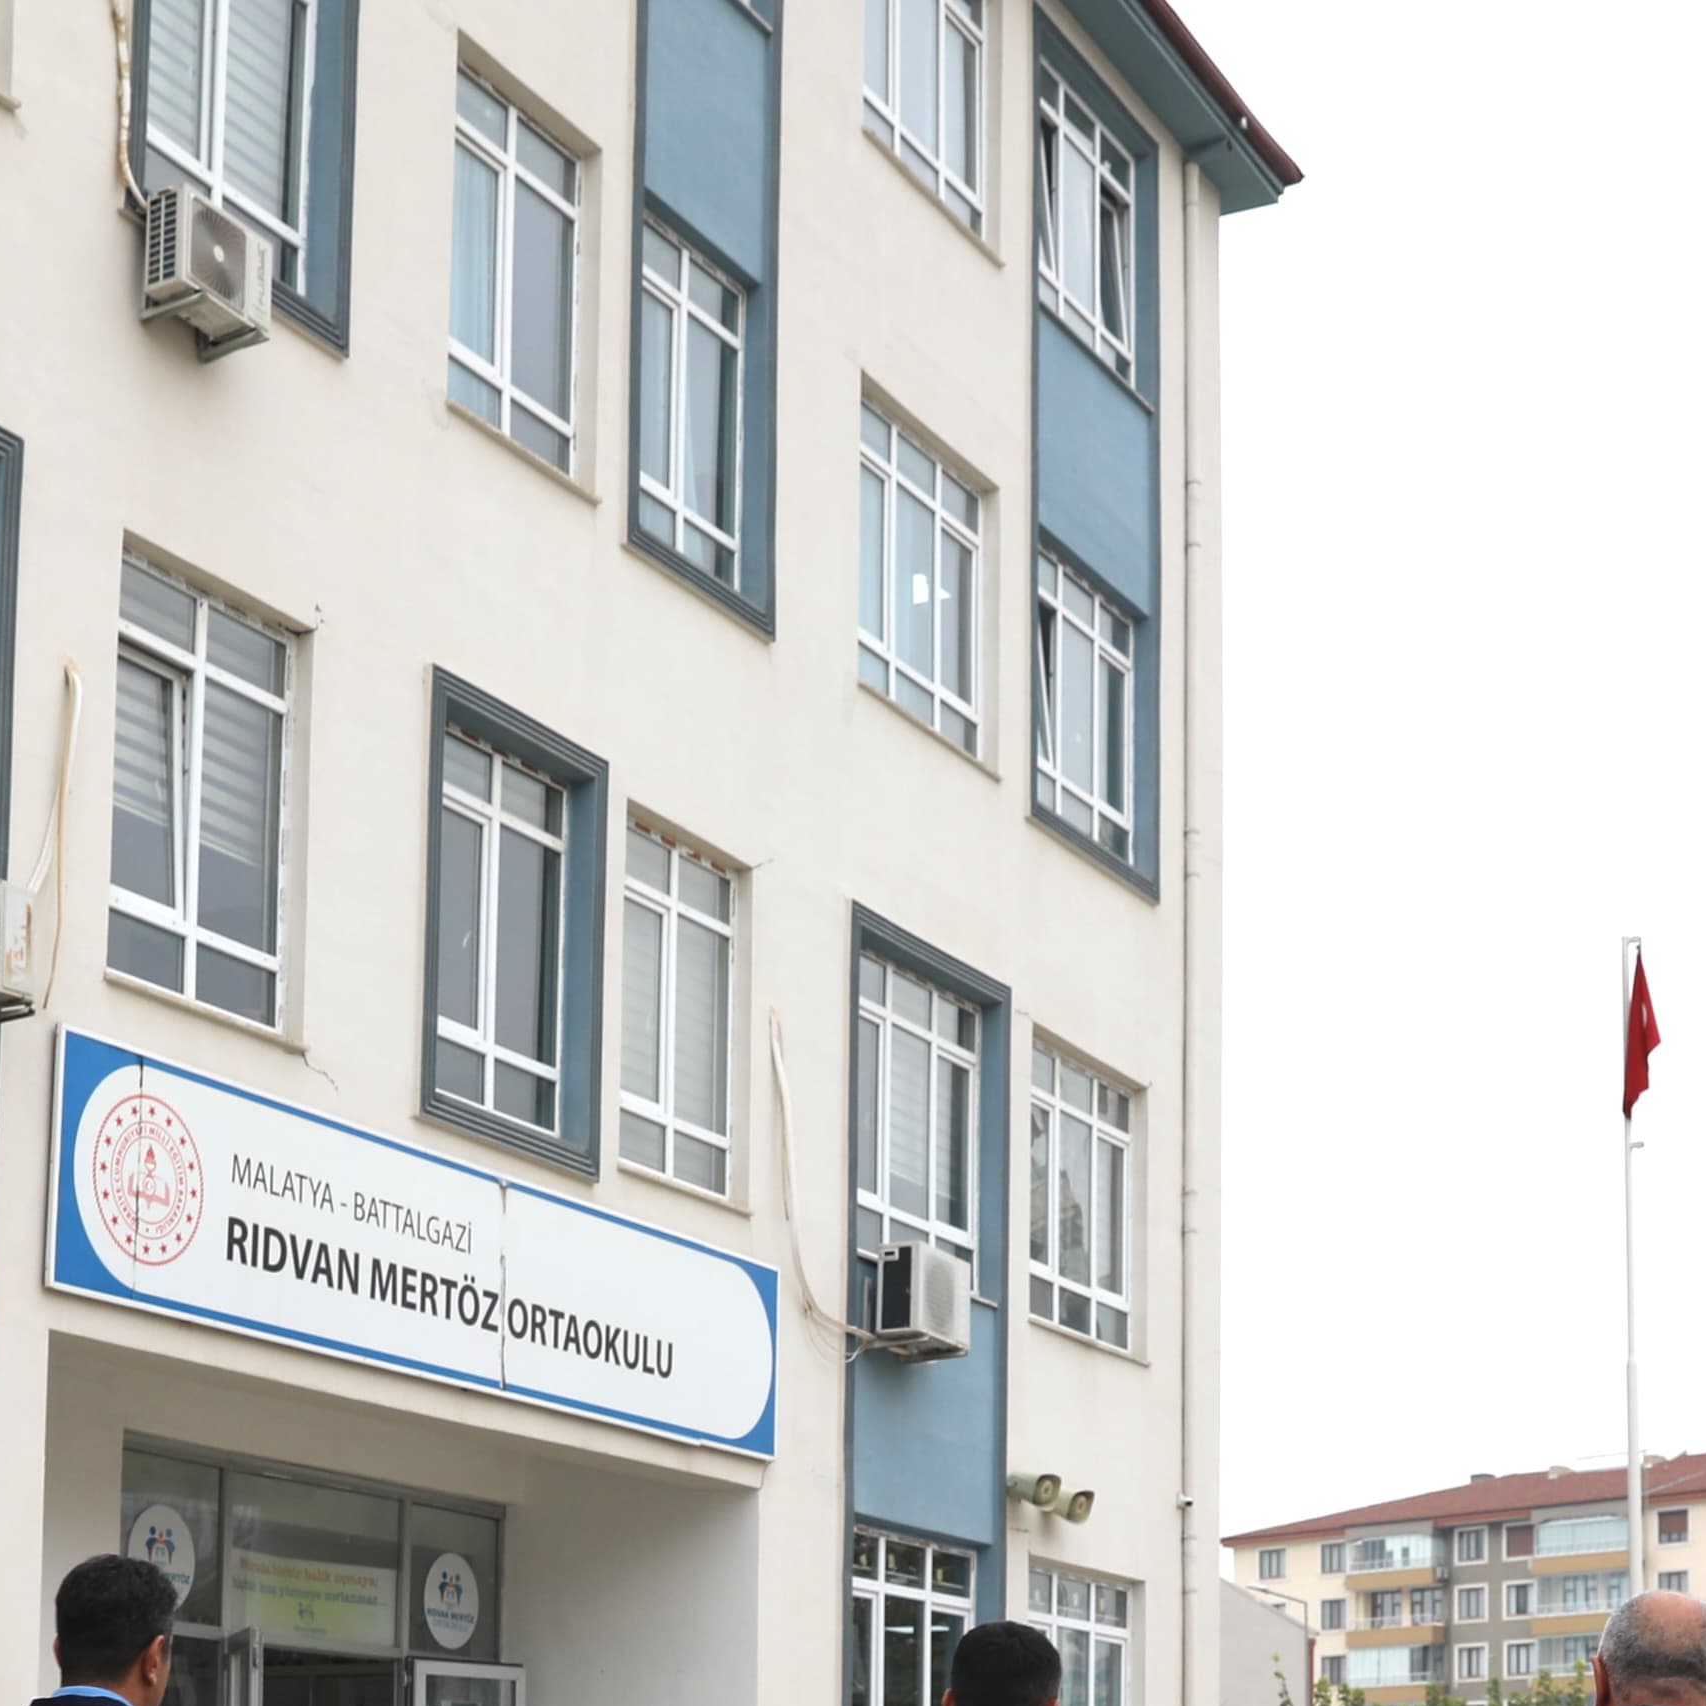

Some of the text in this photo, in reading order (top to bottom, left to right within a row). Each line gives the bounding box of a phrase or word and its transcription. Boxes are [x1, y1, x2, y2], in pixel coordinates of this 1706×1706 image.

[231, 1153, 334, 1213] MALATYA
[353, 1191, 472, 1255] BATTALGAZİ
[226, 1216, 674, 1379] RIDVAN MERTÖZ ORTAOKULU
